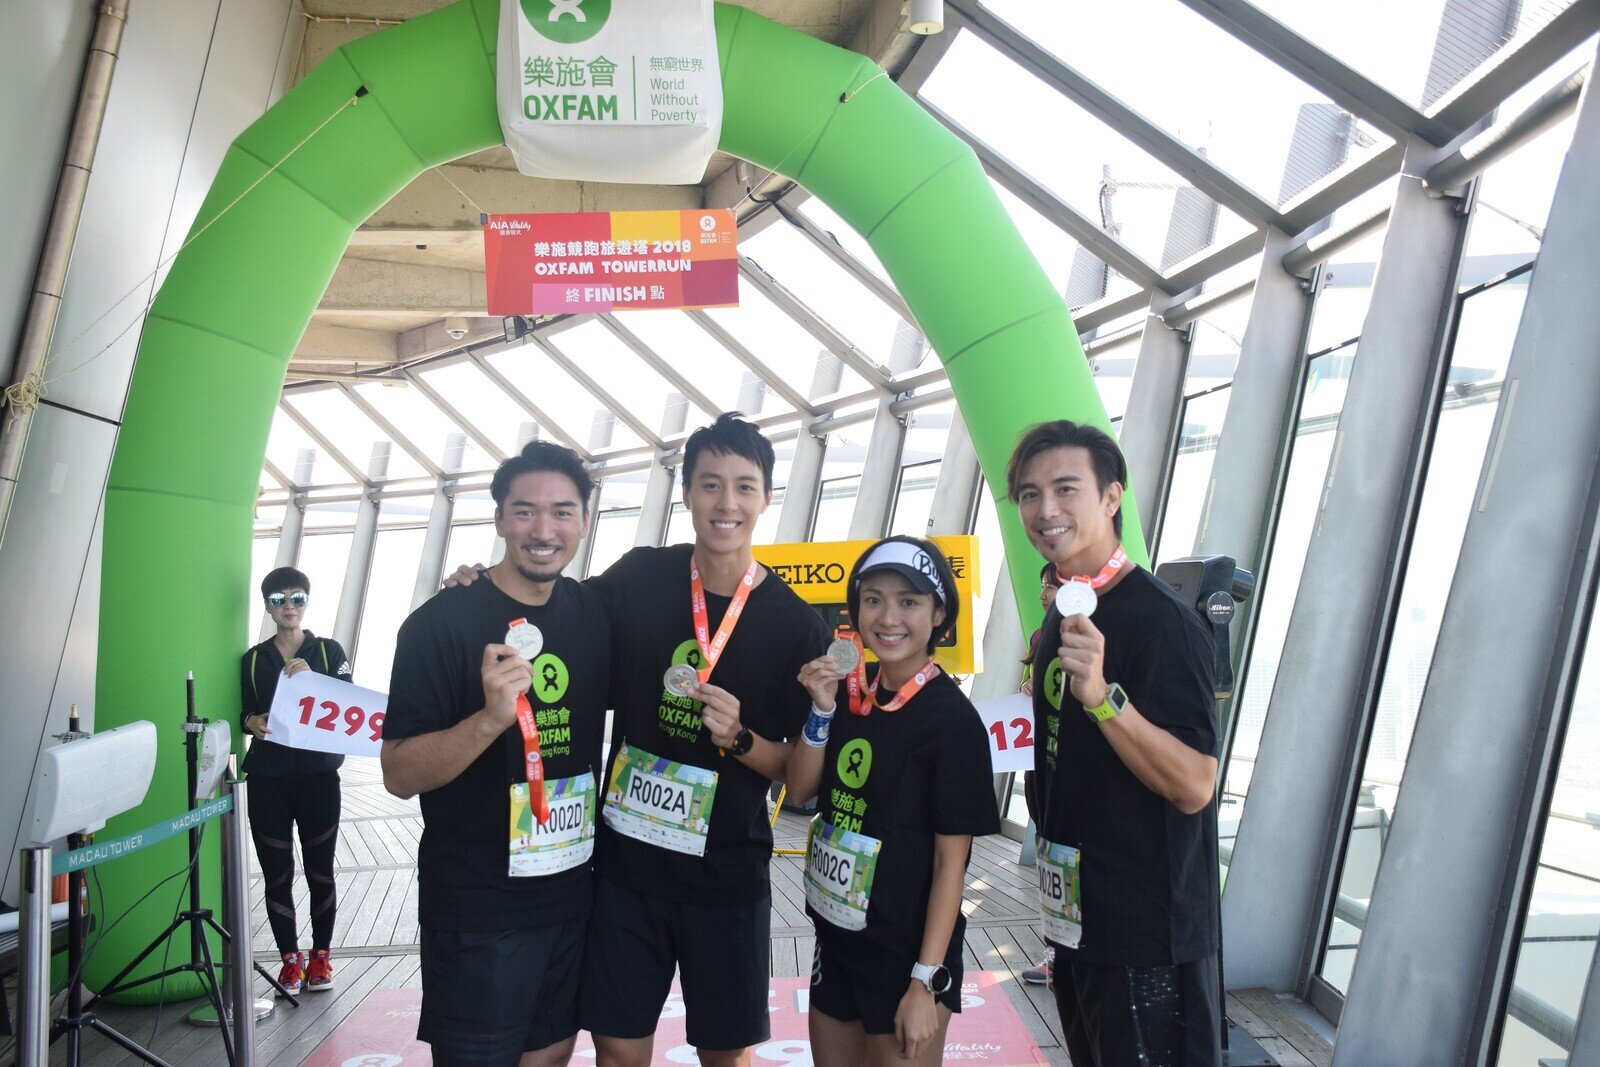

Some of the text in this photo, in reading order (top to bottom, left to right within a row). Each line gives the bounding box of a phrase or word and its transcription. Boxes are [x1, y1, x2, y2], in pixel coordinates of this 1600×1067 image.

[523, 56, 618, 88] 樂施會
[649, 56, 704, 73] 無窮世界
[650, 78, 685, 91] World
[523, 95, 618, 121] OXFAM
[650, 94, 699, 106] Without
[651, 109, 698, 124] Poverty
[490, 221, 509, 230] AIA
[534, 240, 692, 258] 樂施競跑旅遊塔 2018
[535, 260, 692, 277] OXFAM TOWERRUN
[566, 285, 665, 303] 終 FINISH 點
[772, 562, 845, 585] EIKO
[299, 695, 387, 743] 1299
[659, 705, 703, 731] OXFAM
[676, 728, 697, 743] Kong
[553, 746, 570, 756] Kong
[629, 775, 686, 815] R002A
[172, 799, 228, 831] MACAU TOWER
[831, 811, 863, 834] FAM
[69, 834, 143, 868] MACAU TOWER
[811, 842, 850, 886] R002C
